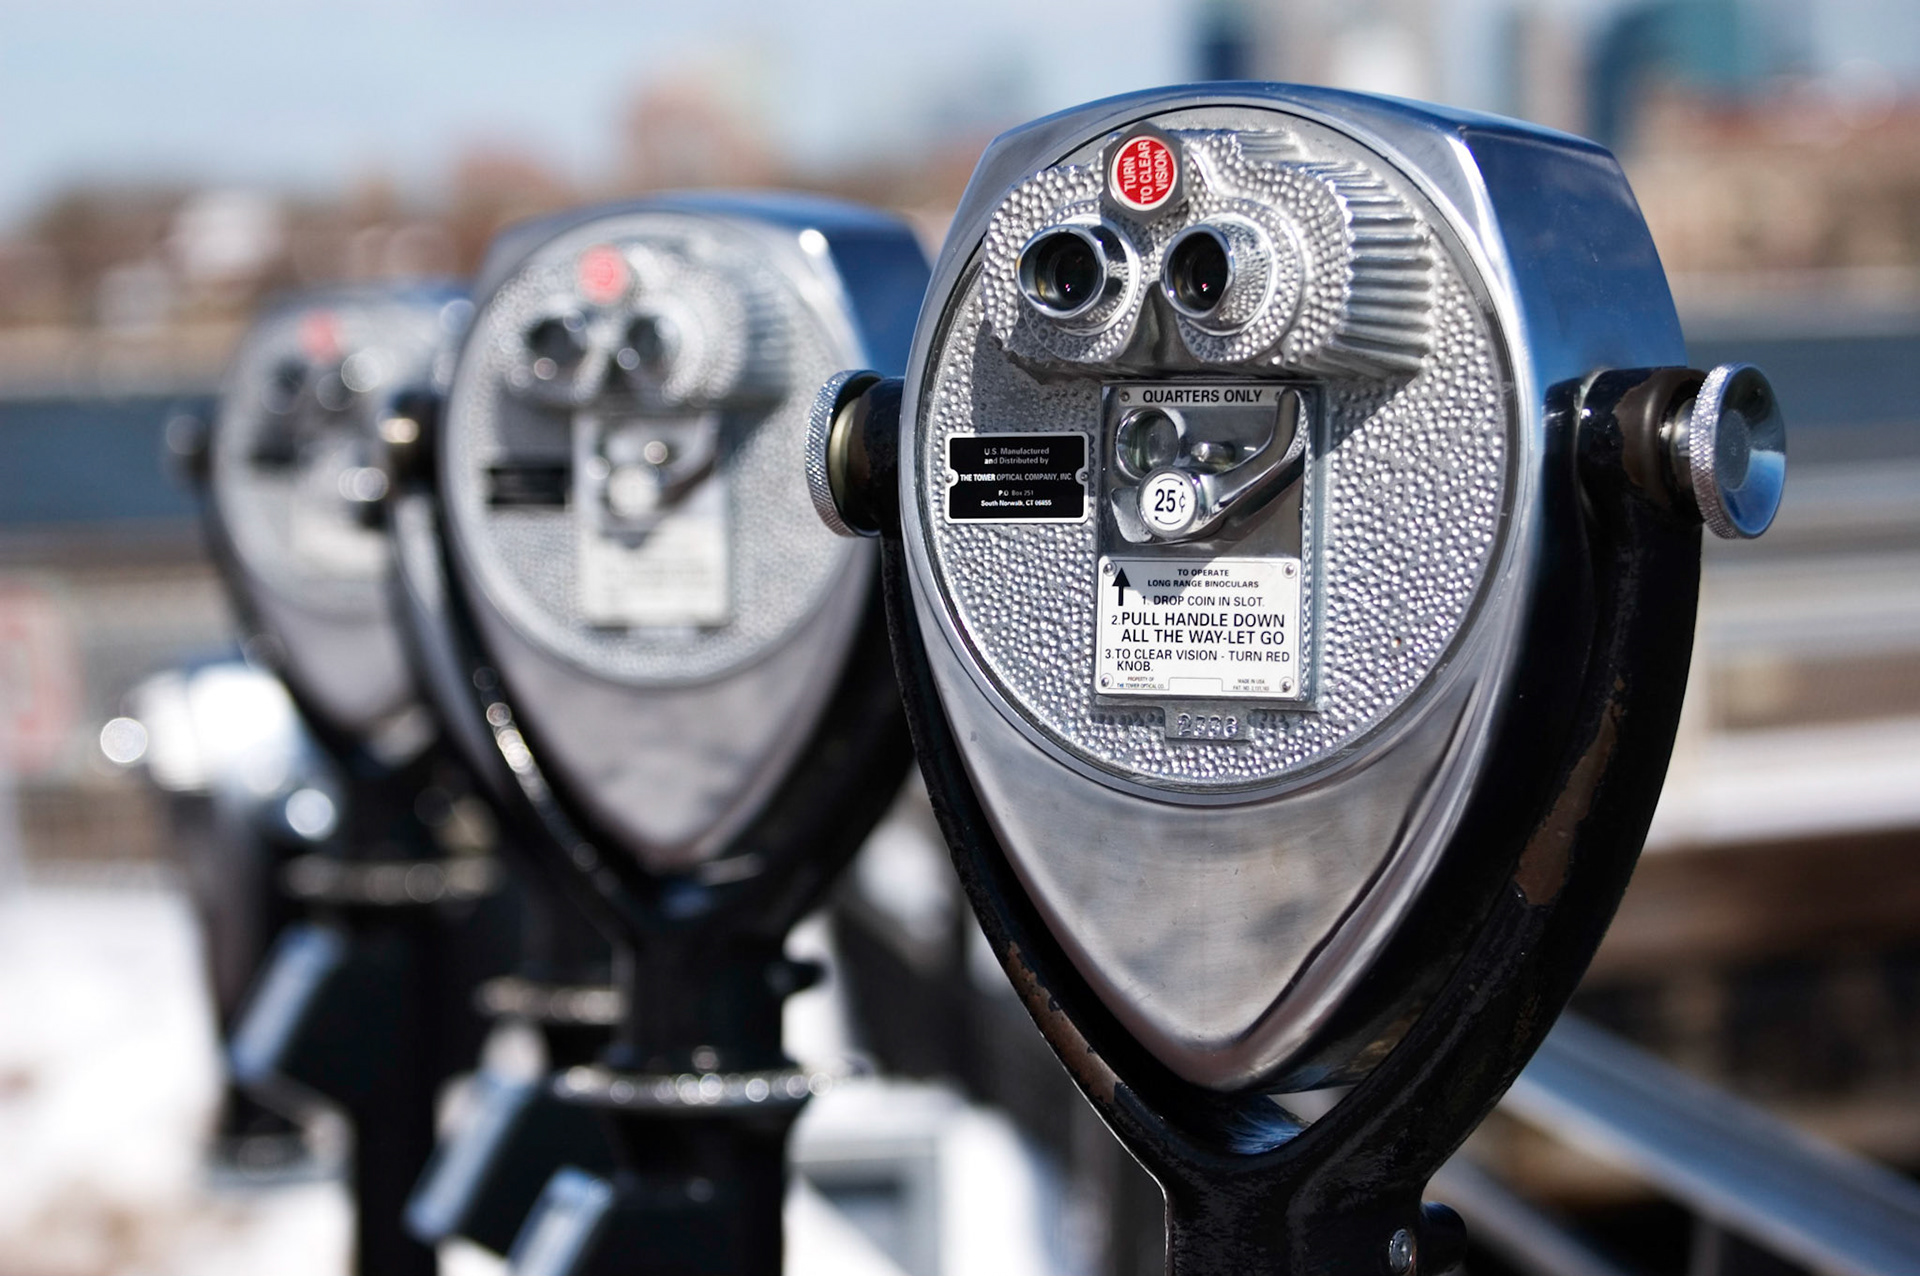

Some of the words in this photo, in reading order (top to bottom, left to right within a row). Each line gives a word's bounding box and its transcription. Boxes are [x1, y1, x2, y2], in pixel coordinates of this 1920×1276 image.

[1138, 141, 1152, 183] CLEAR
[1123, 156, 1137, 192] TURN
[1154, 149, 1169, 192] VISION
[1140, 186, 1153, 204] TO
[1143, 389, 1220, 403] QUARTERS
[1224, 389, 1263, 403] ONLY
[1000, 447, 1049, 455] Manufactured
[984, 457, 997, 465] and
[999, 457, 1039, 465] Distributed
[1040, 457, 1049, 466] by
[997, 473, 1023, 481] OPTICAL
[1154, 488, 1186, 513] 25¢
[1178, 569, 1189, 577] TO
[1191, 569, 1229, 577] OPERATE
[1147, 579, 1171, 587] LONG
[1173, 579, 1202, 588] RANGE
[1205, 580, 1259, 588] BINOCULARS
[1142, 595, 1150, 605] 1.
[1153, 595, 1184, 606] DROP
[1187, 596, 1215, 606] COIN
[1218, 596, 1230, 606] IN
[1233, 596, 1265, 607] SLOT.
[1165, 612, 1228, 627] HANDLE
[1233, 613, 1285, 627] DOWN
[1121, 628, 1149, 642] ALL
[1154, 629, 1183, 643] THE
[1260, 631, 1285, 645] GO
[1134, 649, 1172, 661] CLEAR
[1175, 649, 1218, 661] VISION
[1228, 650, 1262, 662] TURN
[1265, 651, 1290, 662] RED
[1117, 660, 1154, 672] KNOB.
